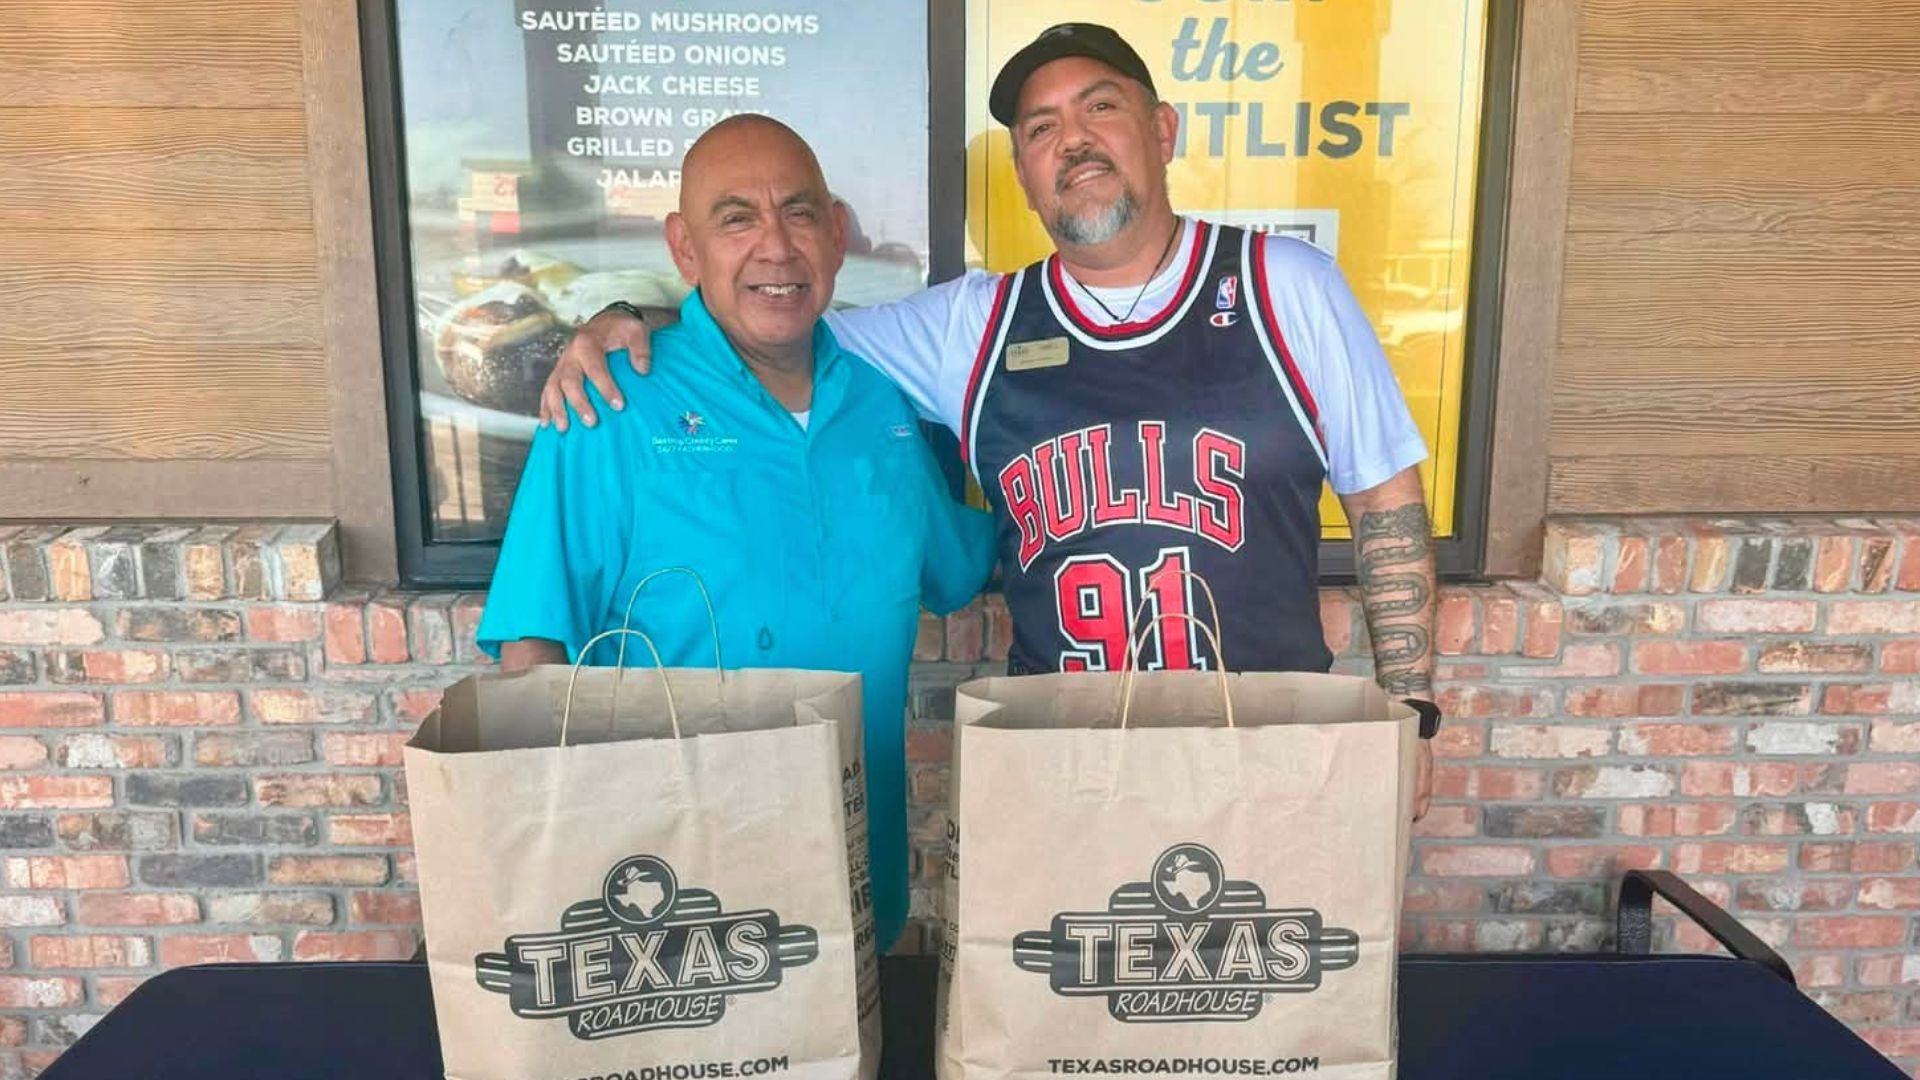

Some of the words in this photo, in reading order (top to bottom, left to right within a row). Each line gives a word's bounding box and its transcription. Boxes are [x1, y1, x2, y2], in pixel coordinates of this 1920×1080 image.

[522, 7, 641, 32] SAUTÉED
[652, 12, 820, 34] MUSHROOMS
[557, 39, 676, 64] SAUTÉED
[685, 46, 787, 66] ONIONS
[1171, 17, 1284, 82] the
[584, 75, 654, 95] JACK
[662, 77, 760, 96] CHEESE
[576, 106, 673, 127] BROWN
[1175, 100, 1410, 159] ITLIST
[567, 137, 674, 157] GRILLED
[597, 168, 682, 188] JALAP
[999, 421, 1245, 574] BULLS
[1054, 547, 1207, 673] 91
[519, 920, 770, 1007] TEXAS
[1065, 918, 1312, 984] TEXAS
[577, 994, 723, 1032] ROADHOUSE
[1114, 990, 1261, 1014] ROADHOUSE
[578, 1055, 789, 1080] OADHOUSE.COM
[1048, 1056, 1320, 1076] TEXASROADHOUSE.COM
